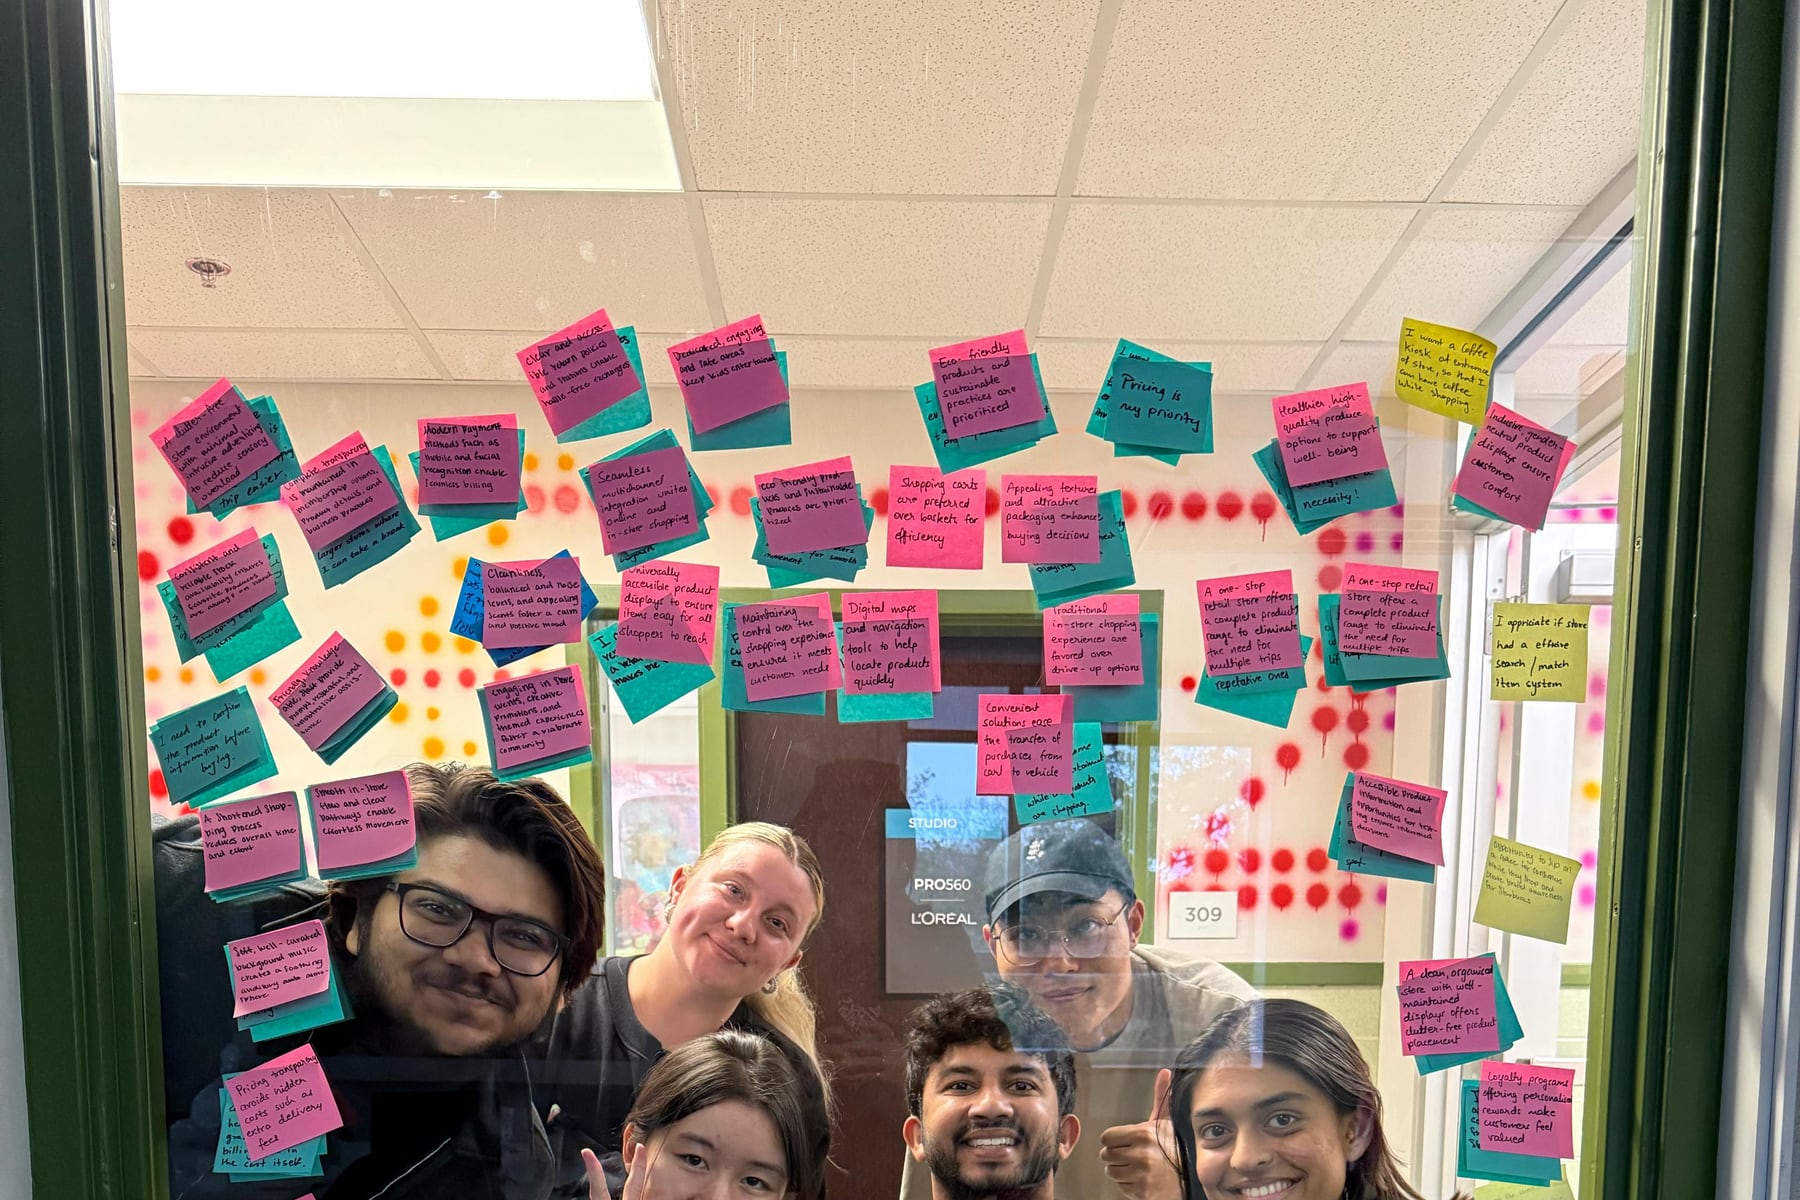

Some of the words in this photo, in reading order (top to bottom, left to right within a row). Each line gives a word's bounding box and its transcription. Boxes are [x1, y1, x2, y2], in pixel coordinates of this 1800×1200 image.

[1405, 328, 1414, 337] I
[1420, 335, 1443, 346] want
[1449, 343, 1456, 351] a
[969, 343, 1010, 361] friendly
[1438, 353, 1449, 363] at
[942, 367, 984, 383] products
[992, 358, 1010, 370] and
[1400, 356, 1410, 365] of
[1457, 370, 1475, 383] that
[943, 376, 1000, 398] sustainable
[1121, 373, 1165, 402] Pricing
[1172, 390, 1182, 401] is
[1399, 369, 1415, 378] can
[1418, 373, 1438, 387] have
[1443, 382, 1473, 397] coffee
[946, 393, 991, 410] practices
[997, 386, 1016, 396] are
[1120, 402, 1141, 419] my
[1148, 407, 1200, 433] priority
[1282, 416, 1320, 434] quality
[1325, 410, 1363, 426] produce
[1285, 435, 1321, 451] options
[1327, 430, 1337, 441] to
[1341, 425, 1379, 442] support
[1328, 444, 1358, 458] being
[597, 465, 652, 484] Seamless
[601, 474, 664, 499] multichannel
[901, 478, 946, 494] Shopping
[952, 479, 978, 490] carts
[601, 495, 649, 512] integration
[658, 484, 688, 498] unites
[897, 497, 918, 505] are
[923, 495, 970, 510] preferred
[606, 512, 637, 526] online
[647, 503, 666, 514] and
[650, 513, 689, 530] shopping
[894, 512, 917, 522] over
[920, 511, 958, 524] baskets
[965, 514, 979, 525] for
[895, 531, 945, 549] efficiency
[848, 602, 885, 616] Digital
[891, 604, 917, 619] maps
[846, 620, 866, 633] and
[870, 619, 926, 635] navigation
[1496, 616, 1504, 627] I
[1554, 618, 1565, 627] if
[1566, 620, 1588, 630] store
[848, 641, 872, 654] tools
[880, 641, 890, 651] to
[895, 638, 918, 654] help
[1496, 640, 1515, 651] had
[1520, 642, 1529, 650] a
[851, 659, 884, 672] locate
[887, 659, 931, 672] products
[1495, 658, 1526, 670] search
[1539, 660, 1569, 671] match
[853, 676, 895, 690] quickly
[1525, 680, 1563, 697] system
[908, 818, 957, 829] STUDIO
[914, 878, 971, 891] PRO560
[1185, 907, 1222, 923] 309
[1406, 968, 1415, 980] A
[1400, 986, 1426, 996] store
[1432, 981, 1452, 992] with
[1403, 994, 1460, 1008] maintained
[1403, 1009, 1445, 1024] displays
[1450, 1006, 1479, 1017] offers
[1466, 1017, 1496, 1033] product
[1407, 1035, 1461, 1050] placement
[235, 1078, 270, 1097] Pricing
[1528, 1076, 1569, 1089] programs
[240, 1092, 270, 1111] avoids
[273, 1078, 306, 1095] hidden
[1482, 1089, 1517, 1104] offering
[244, 1109, 269, 1124] costs
[274, 1096, 297, 1111] such
[301, 1089, 313, 1099] as
[1482, 1107, 1521, 1117] rewards
[1528, 1108, 1556, 1117] make
[246, 1124, 271, 1137] extra
[278, 1103, 324, 1125] delivery
[1484, 1120, 1530, 1132] customers
[1535, 1121, 1553, 1132] feel
[258, 1134, 280, 1149] fees
[1487, 1133, 1525, 1144] valued
